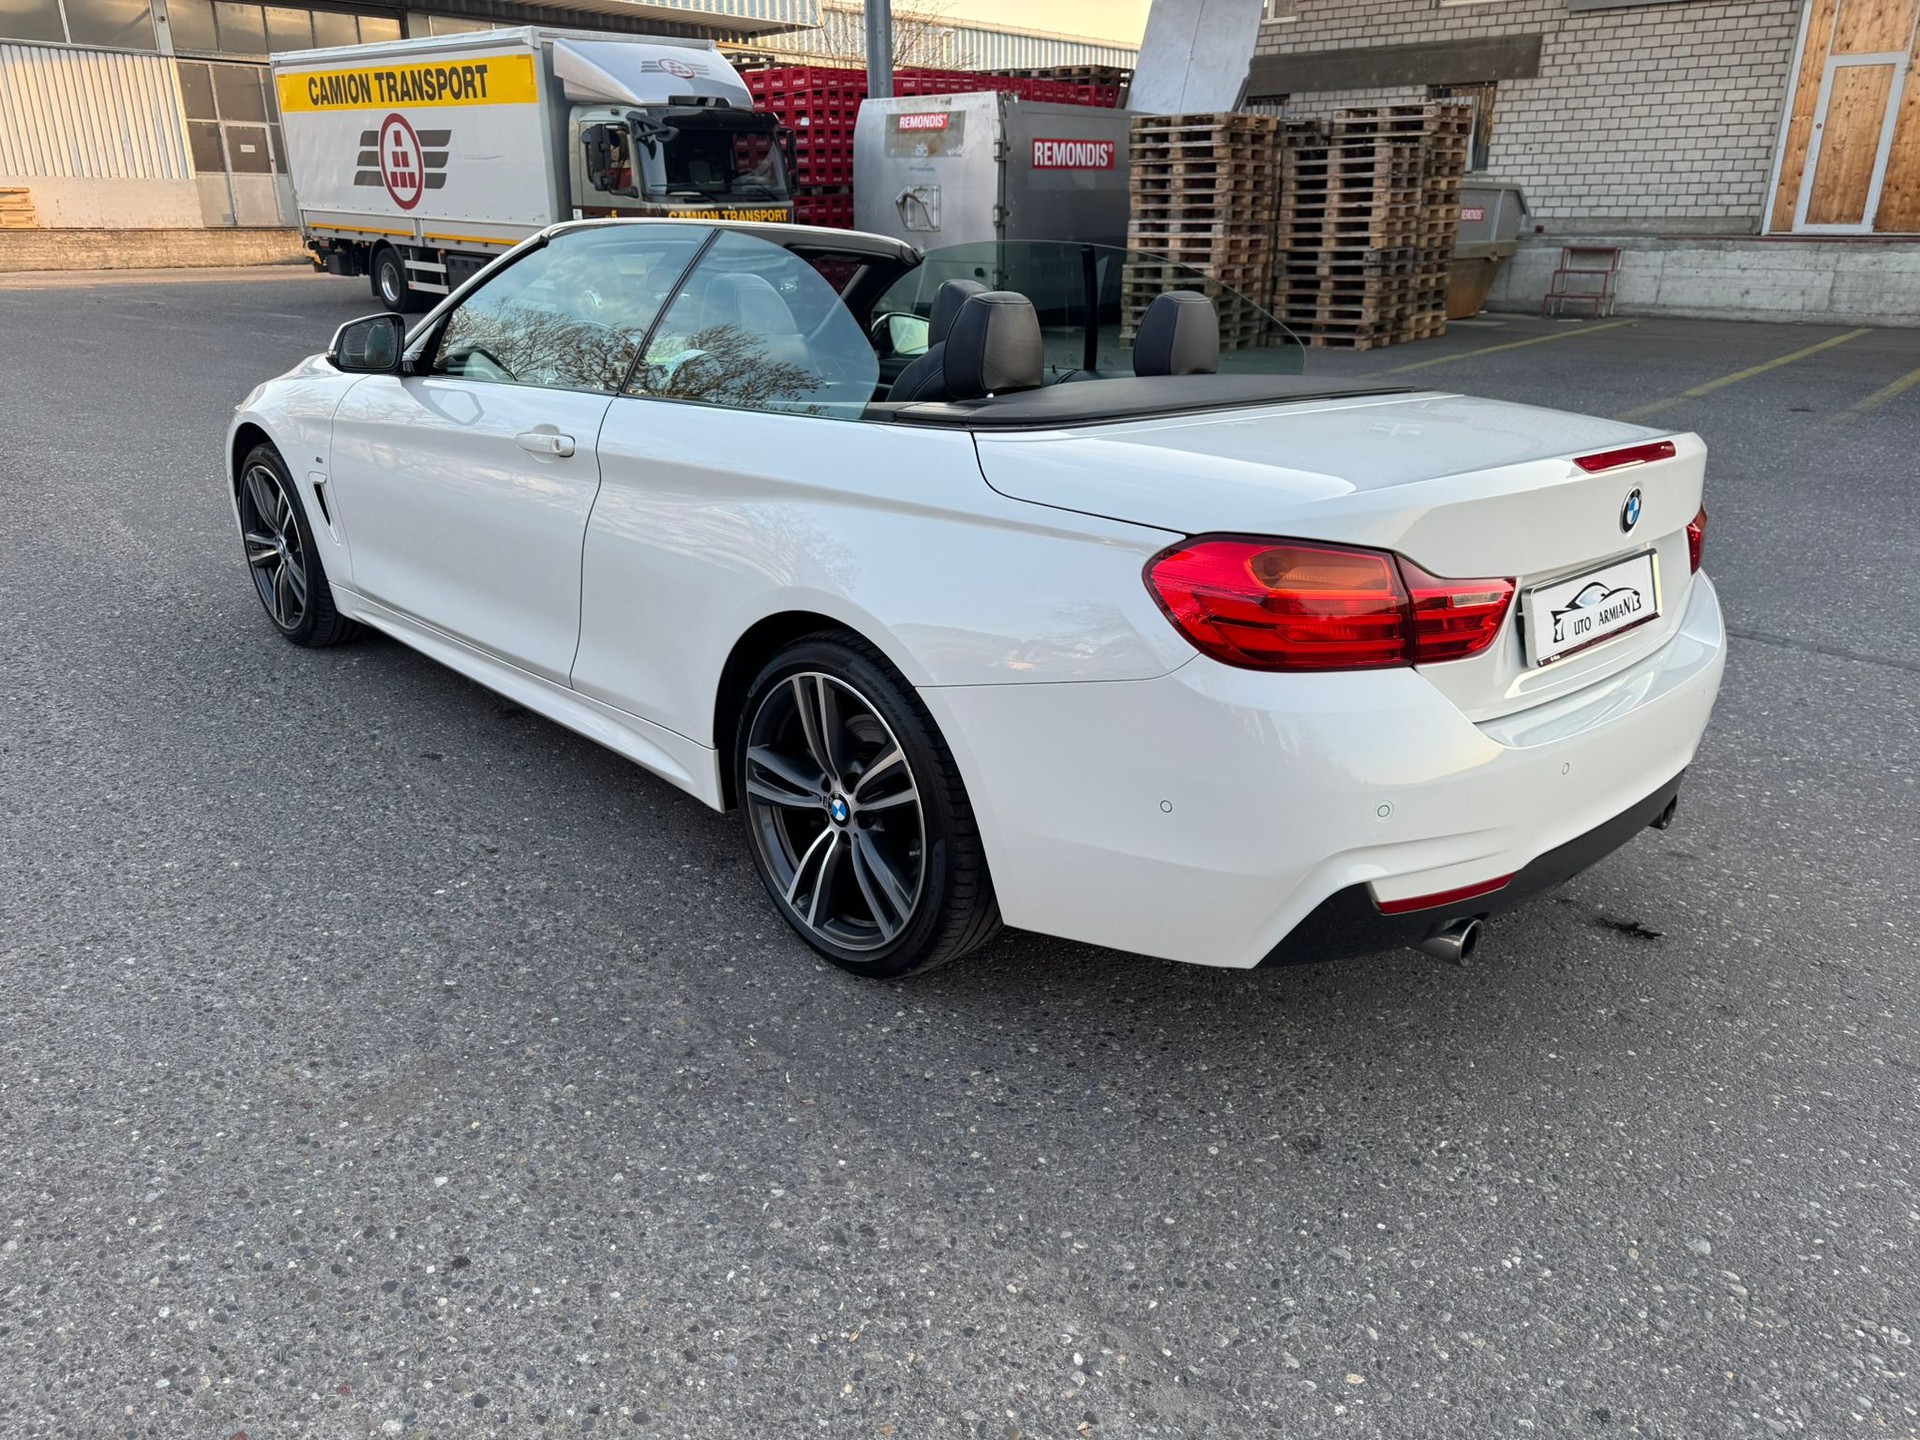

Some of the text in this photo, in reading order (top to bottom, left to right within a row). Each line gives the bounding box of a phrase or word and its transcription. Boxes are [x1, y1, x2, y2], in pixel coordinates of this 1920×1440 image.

[308, 65, 488, 106] CAMION TRANSPORT
[1034, 141, 1108, 167] REMONDIS
[721, 209, 788, 221] TRANSPORT
